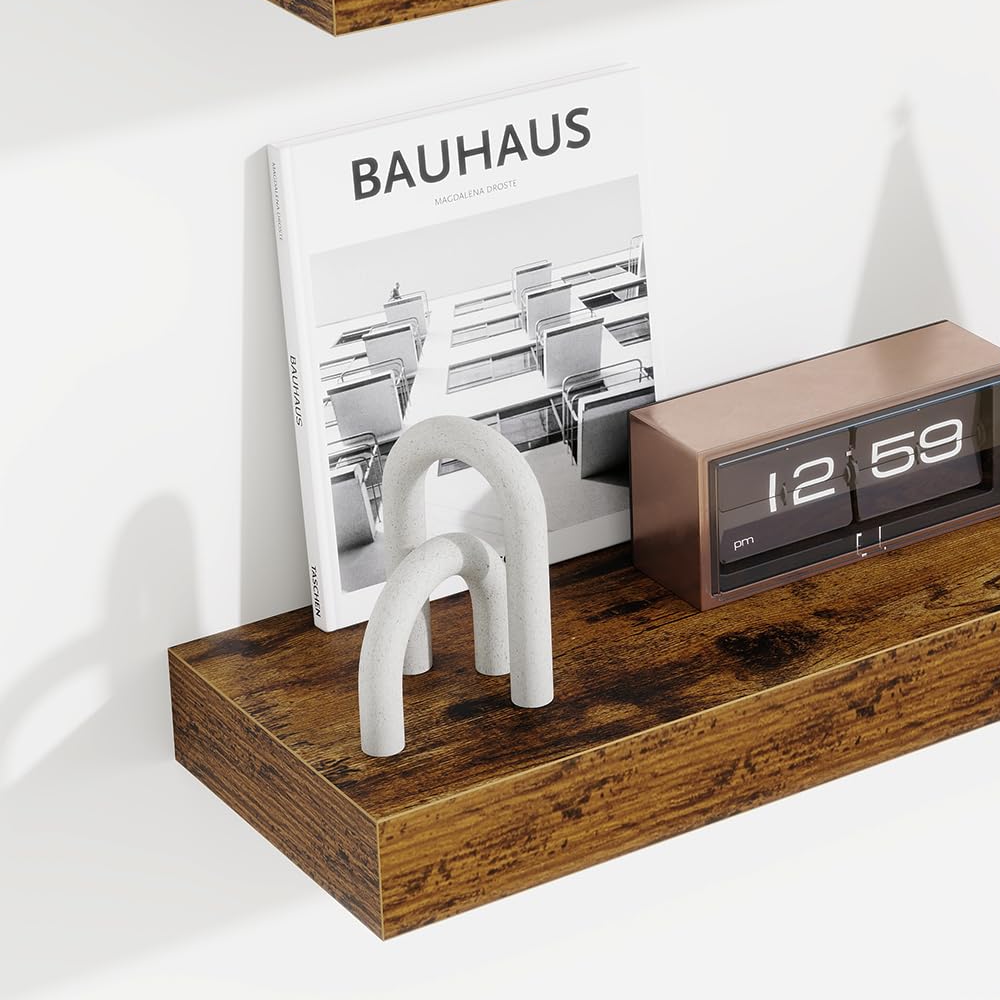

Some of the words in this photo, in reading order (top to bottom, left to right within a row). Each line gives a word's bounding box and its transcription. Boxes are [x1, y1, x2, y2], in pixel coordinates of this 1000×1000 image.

[351, 107, 591, 201] BAUHAUS
[434, 187, 485, 206] MAGDALENA
[486, 179, 518, 194] DROSTE
[289, 355, 303, 427] BAUHAUS
[733, 535, 755, 551] pm
[311, 565, 321, 618] TASCHEN
